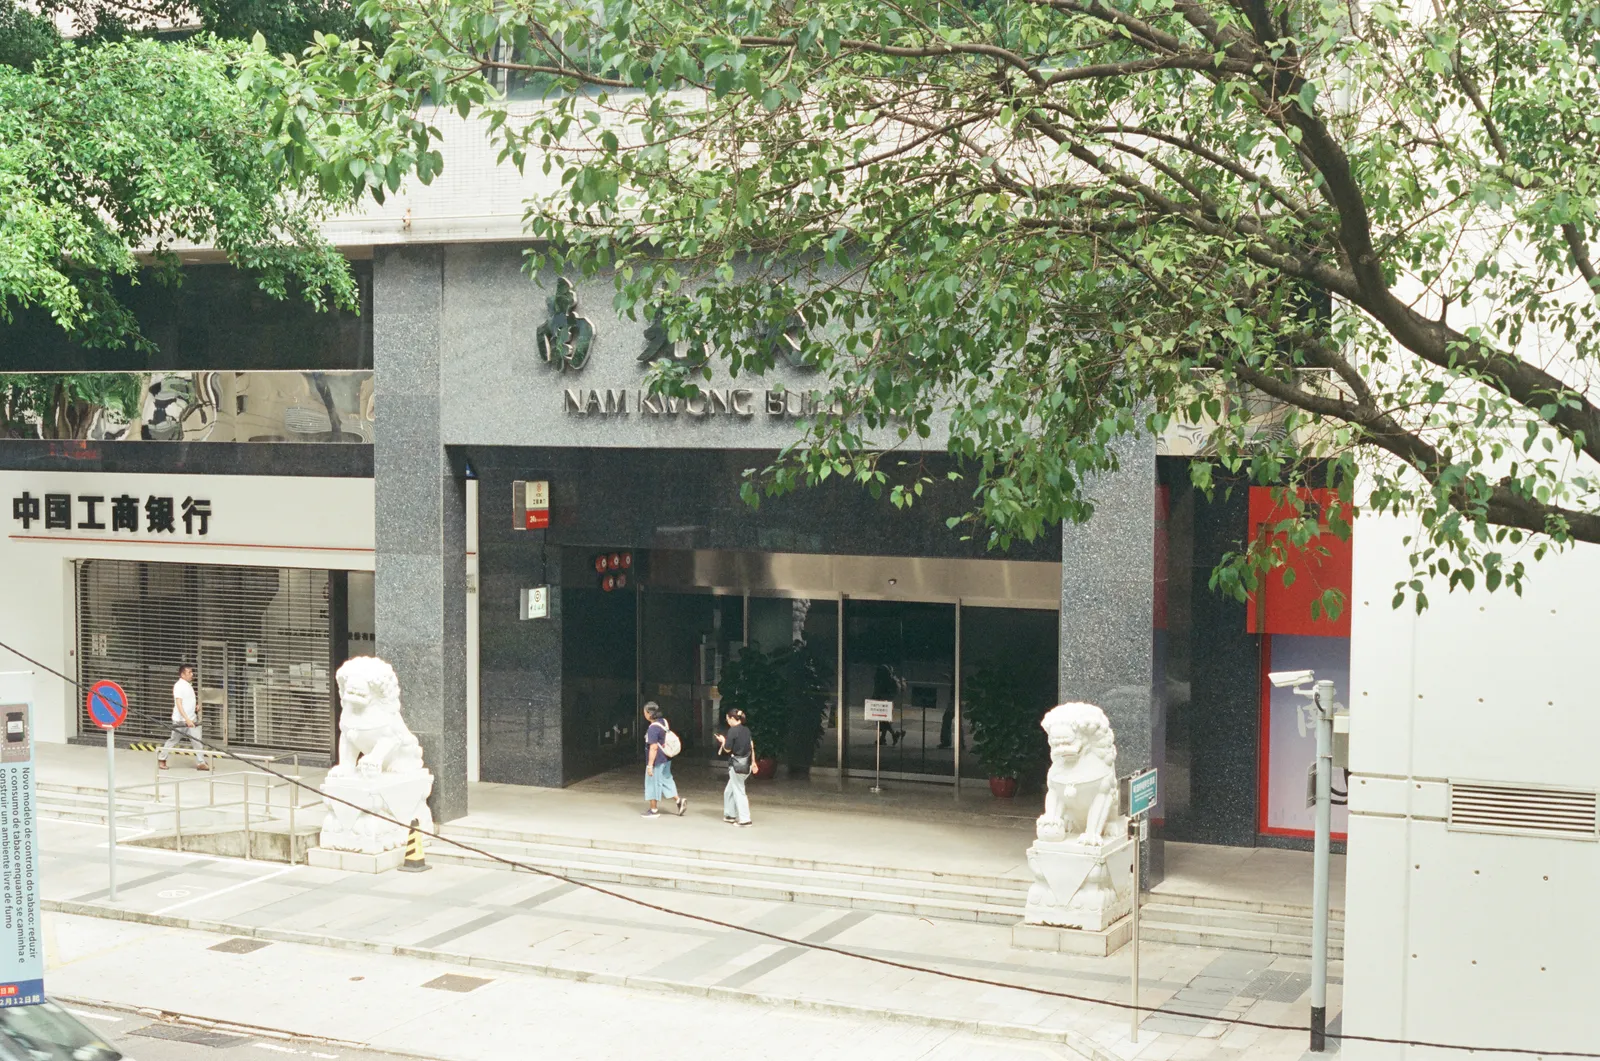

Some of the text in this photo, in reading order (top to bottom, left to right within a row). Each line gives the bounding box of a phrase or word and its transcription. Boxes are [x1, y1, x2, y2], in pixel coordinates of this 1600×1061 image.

[564, 389, 907, 415] NAM KWONG BUID
[13, 491, 212, 535] 中国工商银行
[11, 775, 19, 816] consumo
[24, 792, 32, 826] modelo
[13, 817, 21, 829] de
[25, 828, 32, 839] de
[0, 768, 13, 929] construir um ambiente livre de fumo
[14, 831, 22, 861] tabaco
[25, 840, 34, 878] controlo
[14, 862, 23, 905] enquanto
[26, 880, 34, 891] do
[16, 907, 23, 917] se
[27, 893, 35, 926] tabaco:
[17, 918, 26, 956] caminha
[29, 927, 38, 959] reduzir
